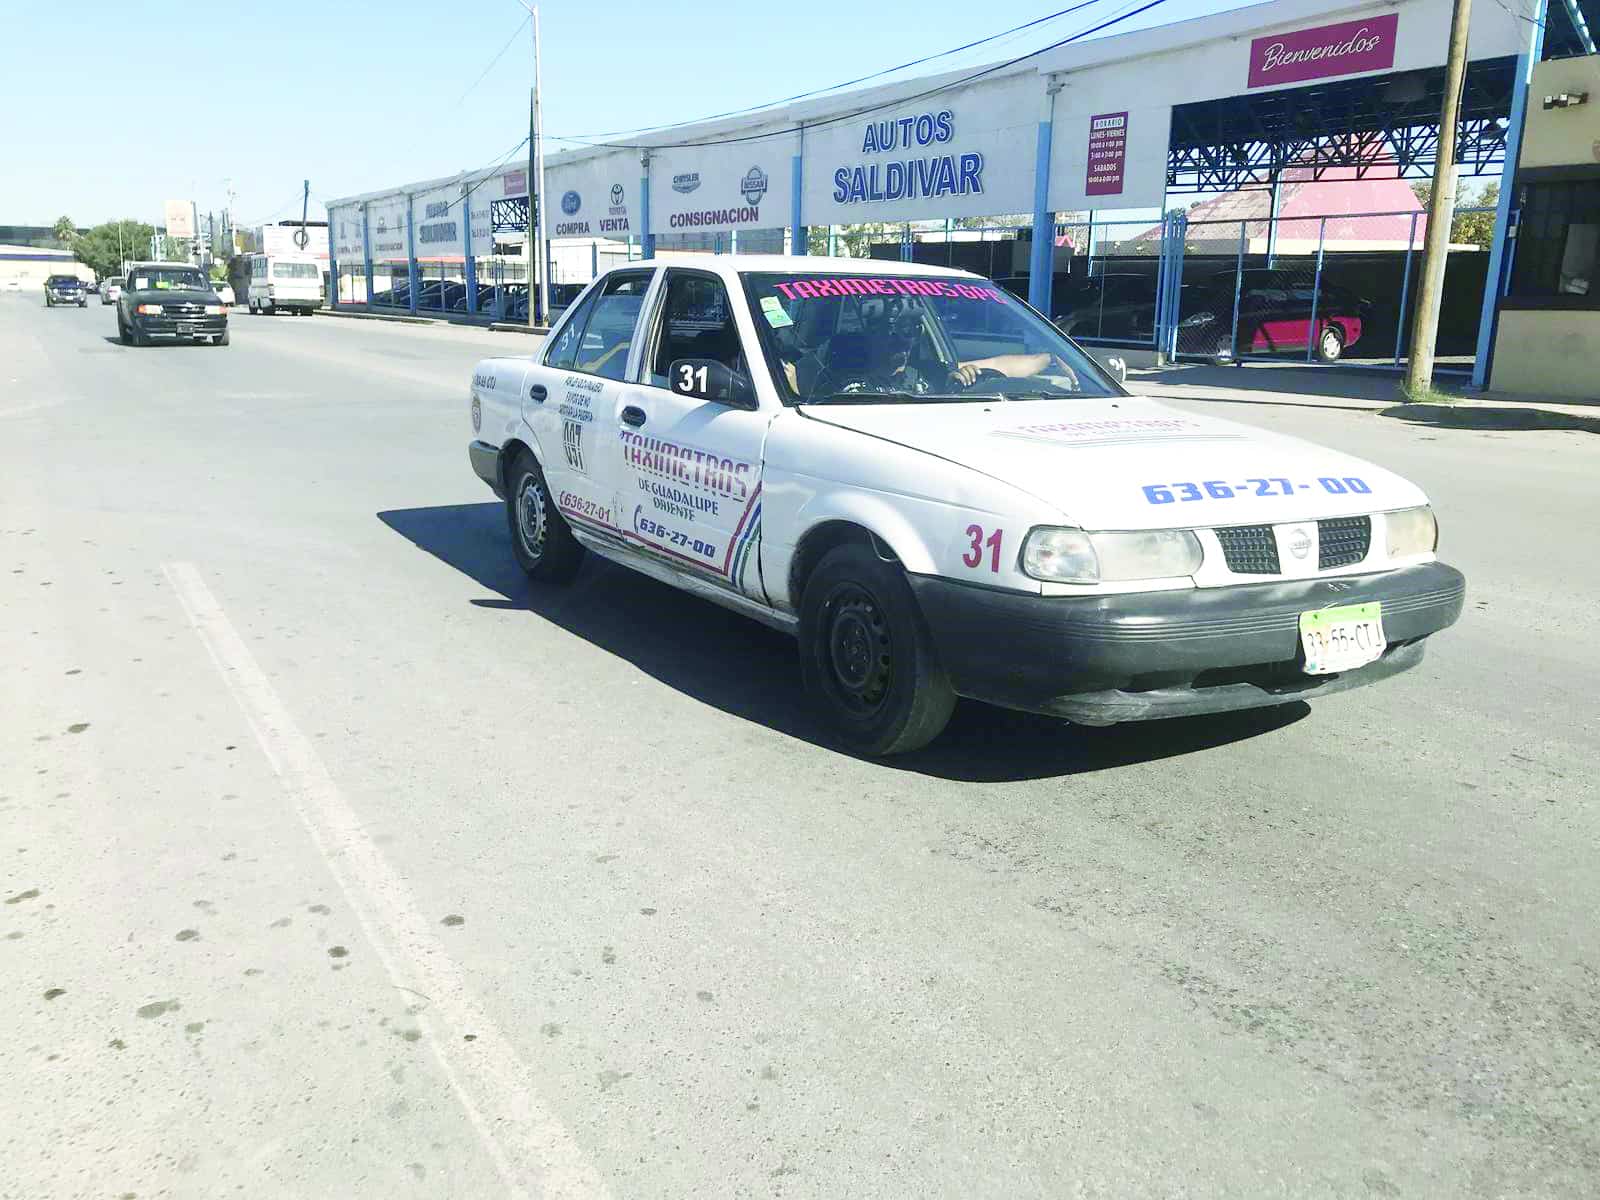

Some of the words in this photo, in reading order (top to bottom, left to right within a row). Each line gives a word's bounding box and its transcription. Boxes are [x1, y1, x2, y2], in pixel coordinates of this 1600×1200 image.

[1262, 27, 1384, 72] Bienvenidos
[861, 110, 954, 153] AUTOS
[1095, 118, 1123, 128] HORARIO
[833, 151, 985, 205] SALDIVAR
[556, 222, 590, 235] COMPRA
[599, 218, 630, 231] VENTA
[670, 206, 759, 228] CONSIGNACION
[773, 278, 959, 300] TAXIMETROS
[678, 364, 709, 393] 31
[651, 482, 719, 516] GUADALUPE
[653, 496, 696, 521] ORIENTE
[962, 523, 1004, 573] 31
